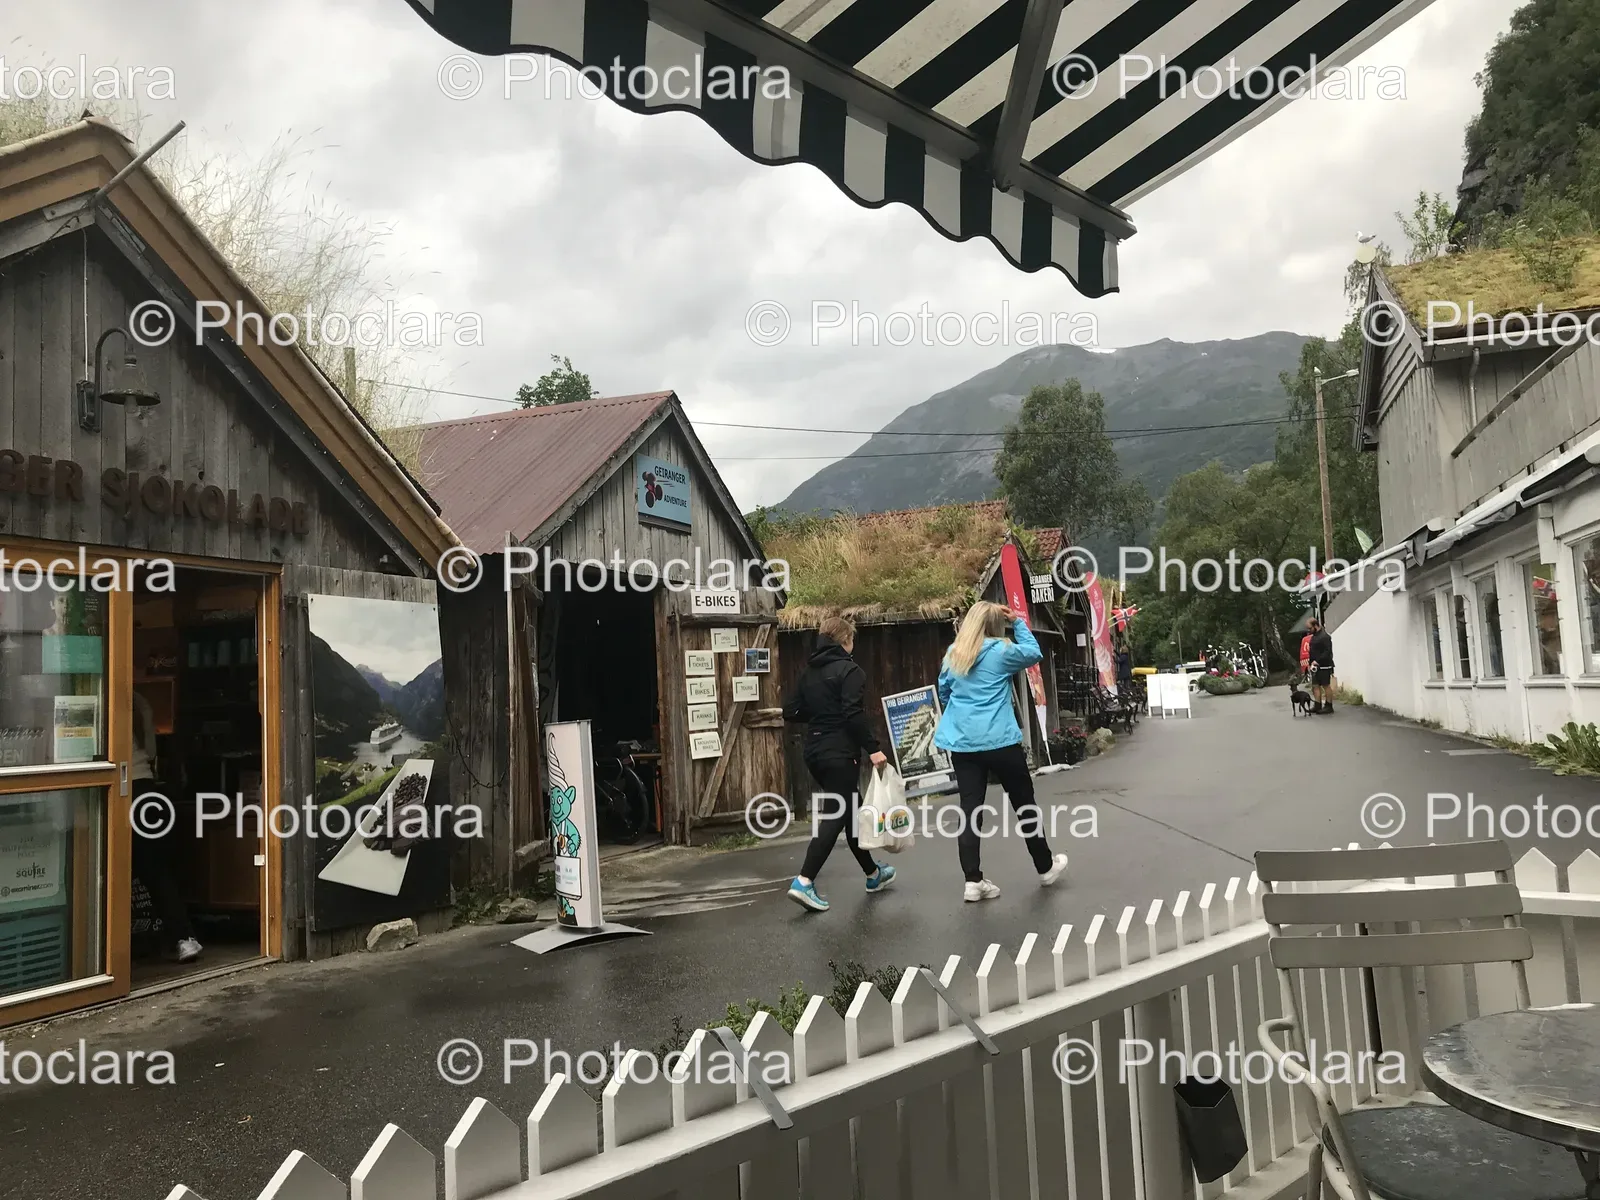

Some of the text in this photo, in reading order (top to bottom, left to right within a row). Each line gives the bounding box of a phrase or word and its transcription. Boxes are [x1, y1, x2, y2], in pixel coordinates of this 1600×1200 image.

[654, 465, 686, 485] GEIRANGER
[663, 494, 687, 508] ADVENTURE
[1029, 574, 1053, 585] GEIRANGER
[695, 595, 736, 607] E-BIKES
[1030, 587, 1055, 604] BAKERI
[896, 691, 928, 706] GEIRANGER
